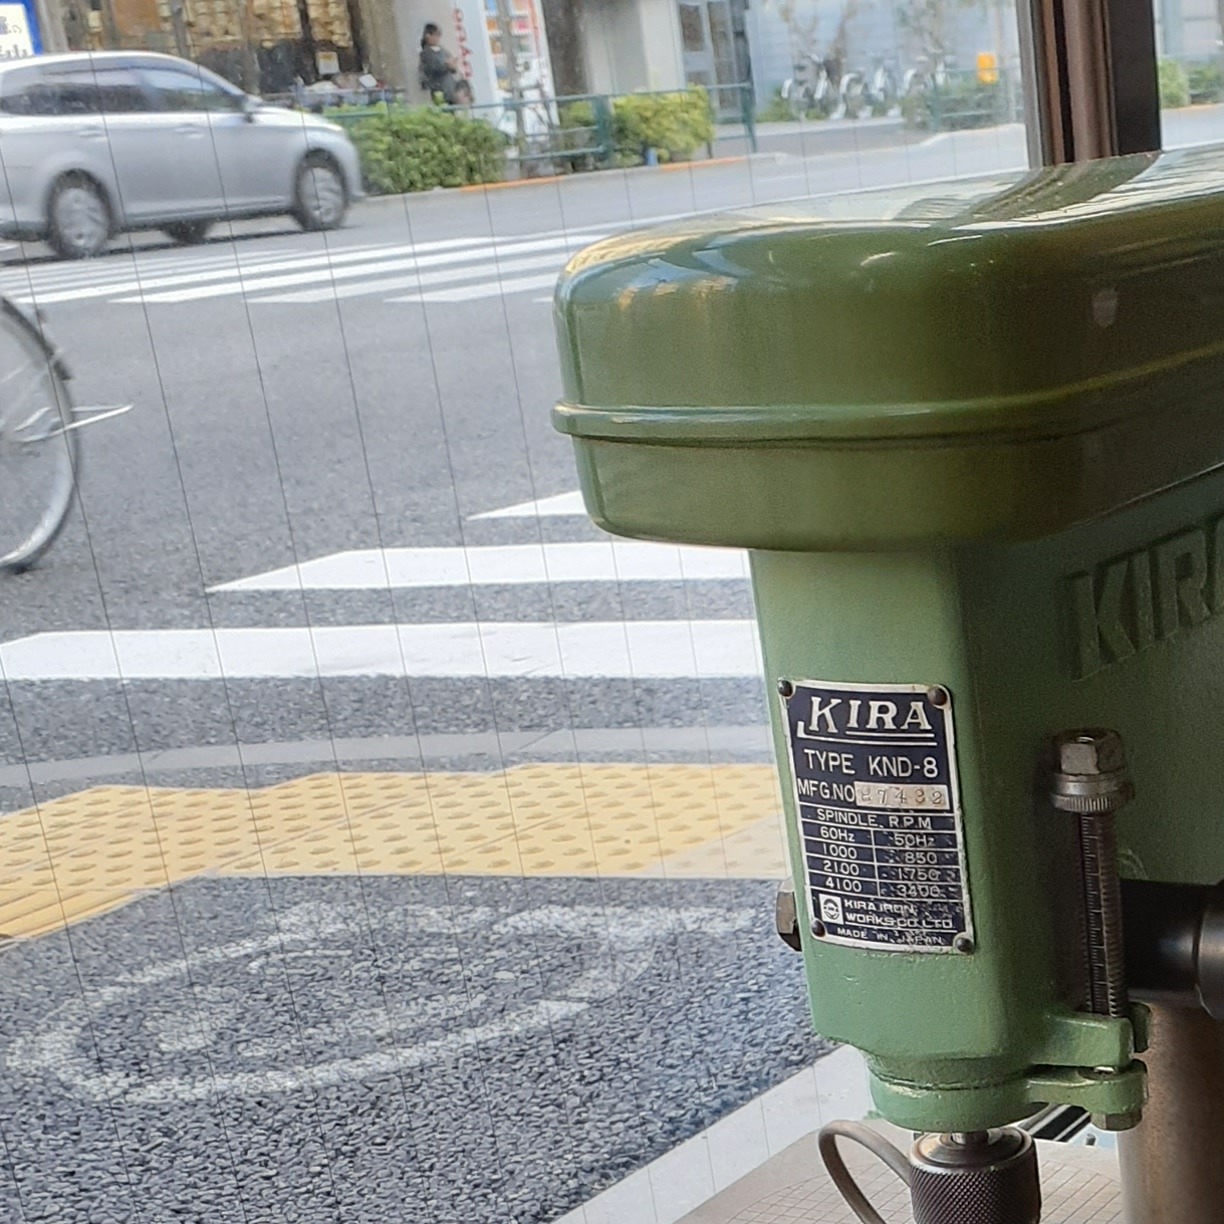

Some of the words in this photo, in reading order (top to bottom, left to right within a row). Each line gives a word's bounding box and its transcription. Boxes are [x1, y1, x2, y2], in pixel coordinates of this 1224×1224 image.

[808, 696, 933, 733] KIRA
[803, 749, 855, 774] TYPE
[868, 755, 939, 778] KND-8
[797, 778, 855, 802] MFG.NO
[820, 826, 856, 842] 60Hz
[894, 833, 935, 847] 50Hz
[822, 843, 858, 860] 1000
[905, 851, 938, 864] 850
[823, 860, 860, 876] 2100
[898, 867, 941, 881] 1750
[825, 877, 863, 893] 4100
[896, 884, 941, 898] 3400
[844, 899, 877, 911] KIRA
[878, 903, 915, 915] IRON
[845, 912, 895, 927] WORKS
[837, 927, 869, 940] MADE
[876, 932, 889, 941] IN
